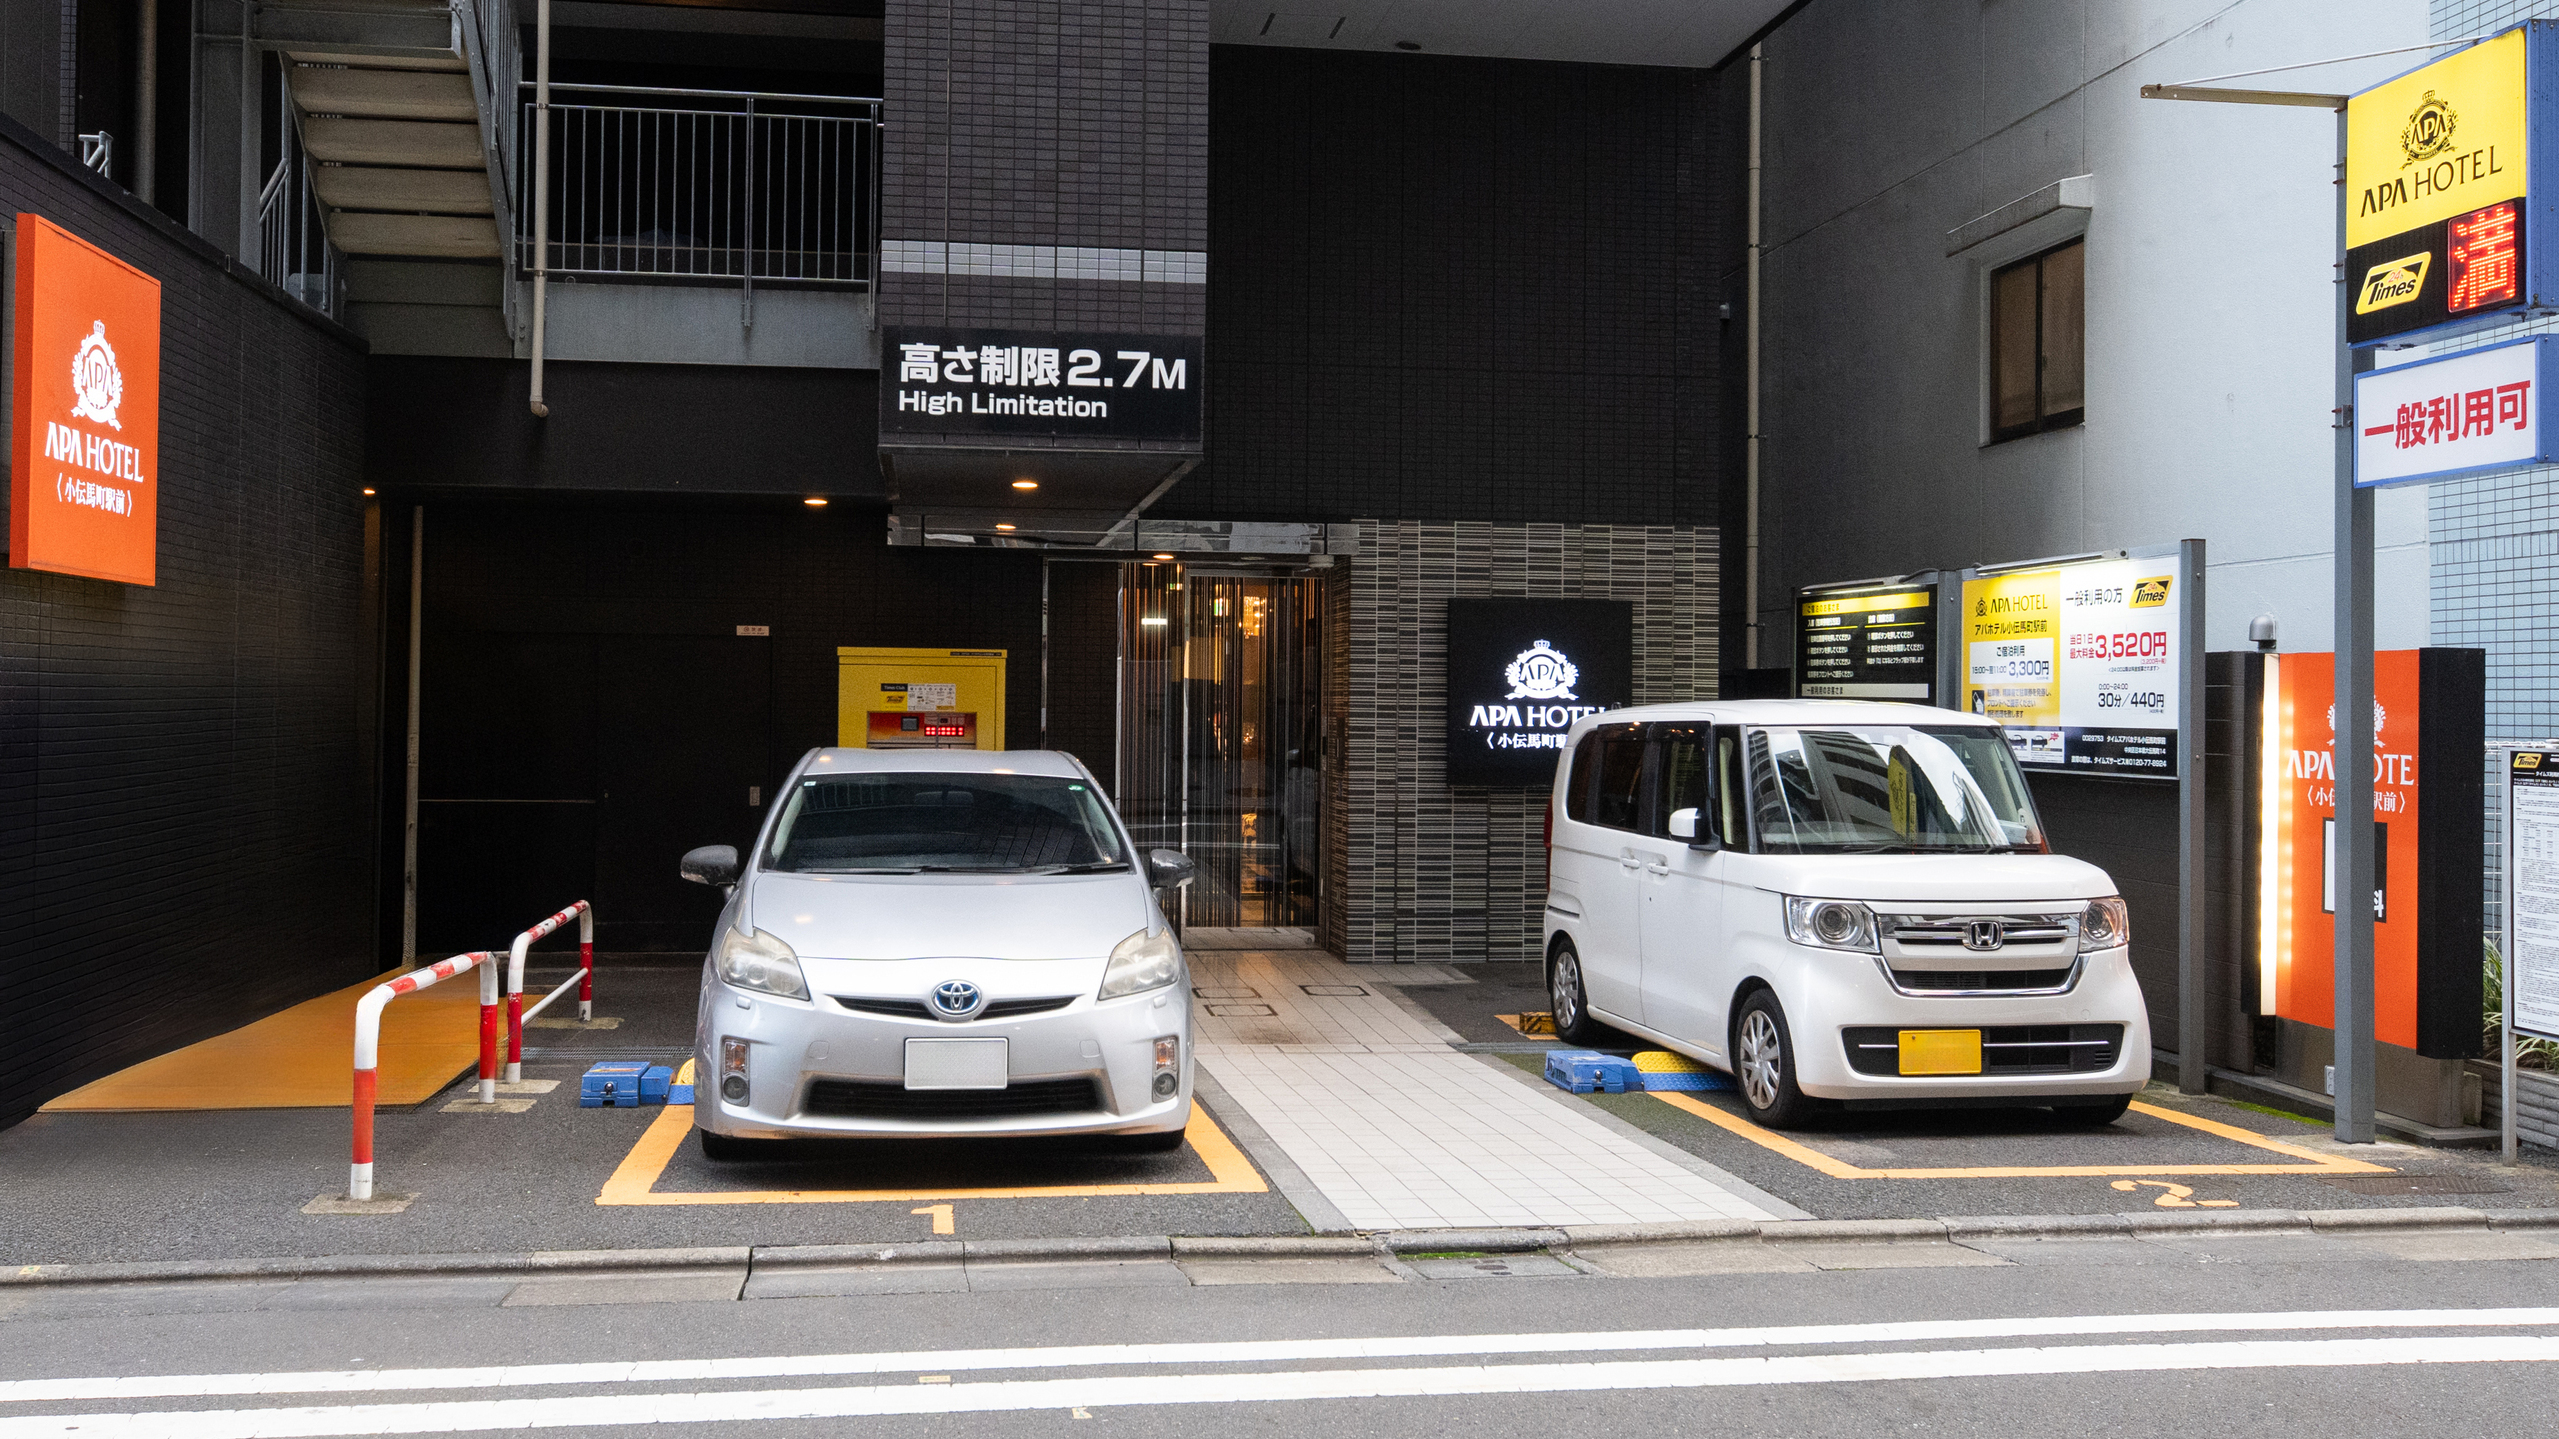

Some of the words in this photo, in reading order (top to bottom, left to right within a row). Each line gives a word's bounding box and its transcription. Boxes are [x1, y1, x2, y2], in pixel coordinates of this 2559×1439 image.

[2360, 177, 2408, 218] APA
[2414, 145, 2503, 200] HOTEL
[2454, 206, 2517, 309] 満
[2367, 278, 2417, 306] Times
[898, 390, 963, 416] High
[971, 392, 1108, 418] Limitation
[2364, 379, 2531, 450] 一般利用可
[44, 421, 84, 467] APA
[85, 433, 144, 483] HOTEL
[1990, 598, 2011, 614] APA
[2012, 594, 2048, 612] HOTEL
[2065, 587, 2123, 607] 一般利用の方
[2135, 589, 2166, 604] Times
[2095, 631, 2167, 662] 3,520円
[2008, 660, 2050, 679] 3,300円
[1469, 705, 1523, 727] APA
[2285, 750, 2335, 780] APA
[2110, 1179, 2240, 1207] 2
[911, 1204, 955, 1235] 1
